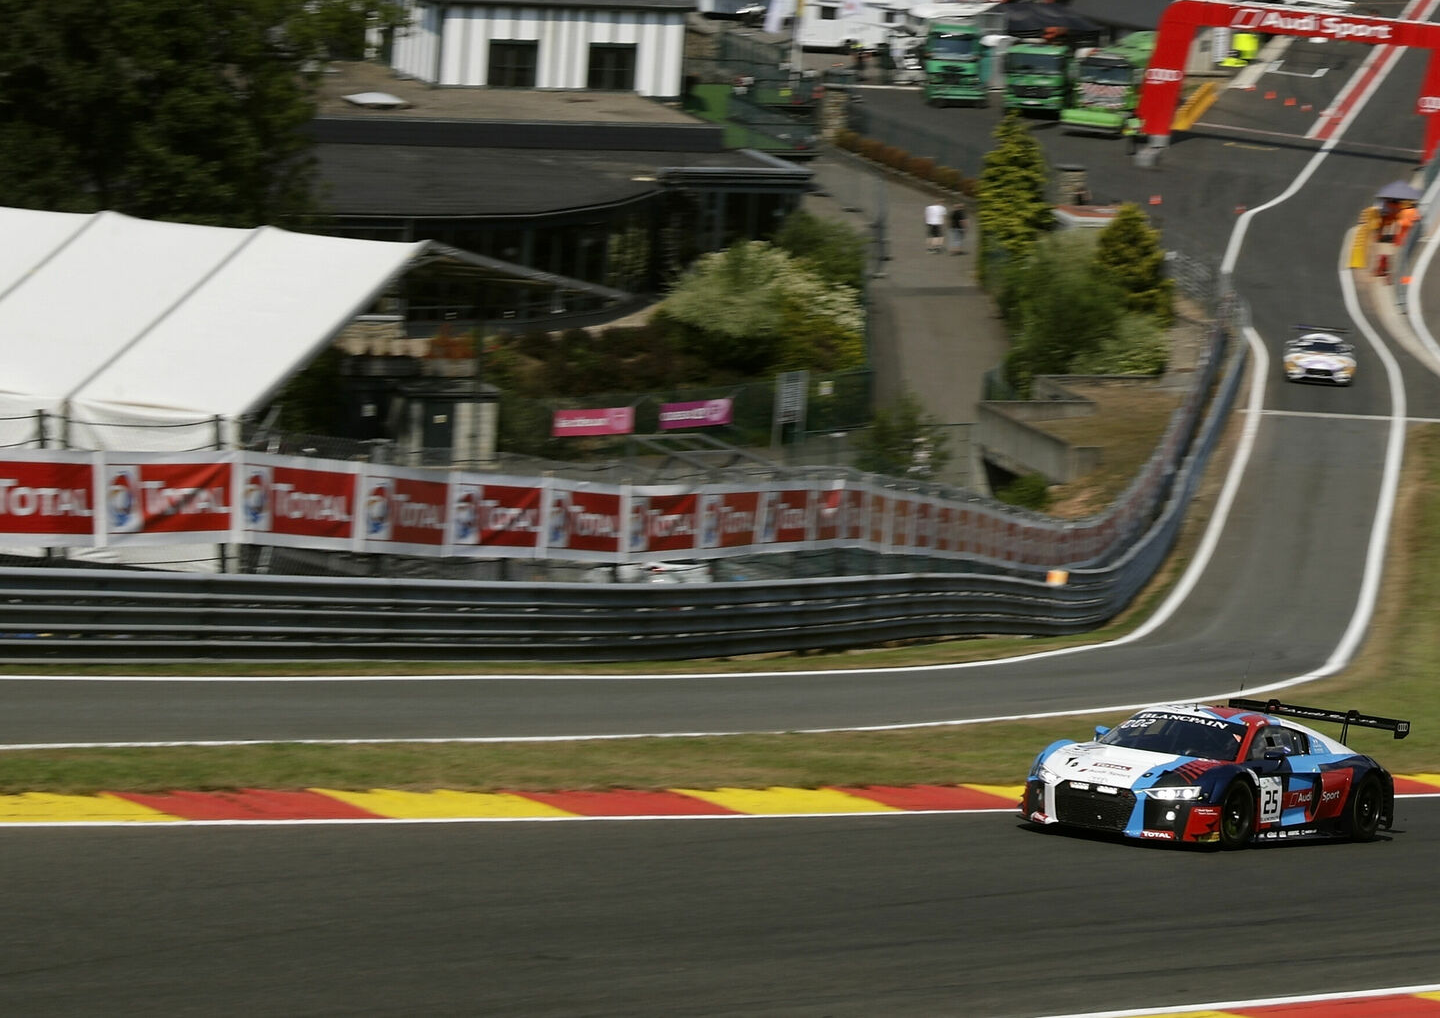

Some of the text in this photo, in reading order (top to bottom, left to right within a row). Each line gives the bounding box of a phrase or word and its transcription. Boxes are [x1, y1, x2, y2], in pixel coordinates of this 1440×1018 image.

[1260, 10, 1393, 39] Audi Sport
[0, 478, 93, 517] TOTAL
[140, 480, 232, 515] TOTAL
[272, 483, 353, 522] TOTAL
[391, 494, 449, 530] TOTAL
[1139, 712, 1229, 730] BLANCPAIN
[1263, 790, 1279, 815] 25
[1297, 790, 1340, 804] Audi Sport
[1142, 831, 1172, 839] TOTAL
